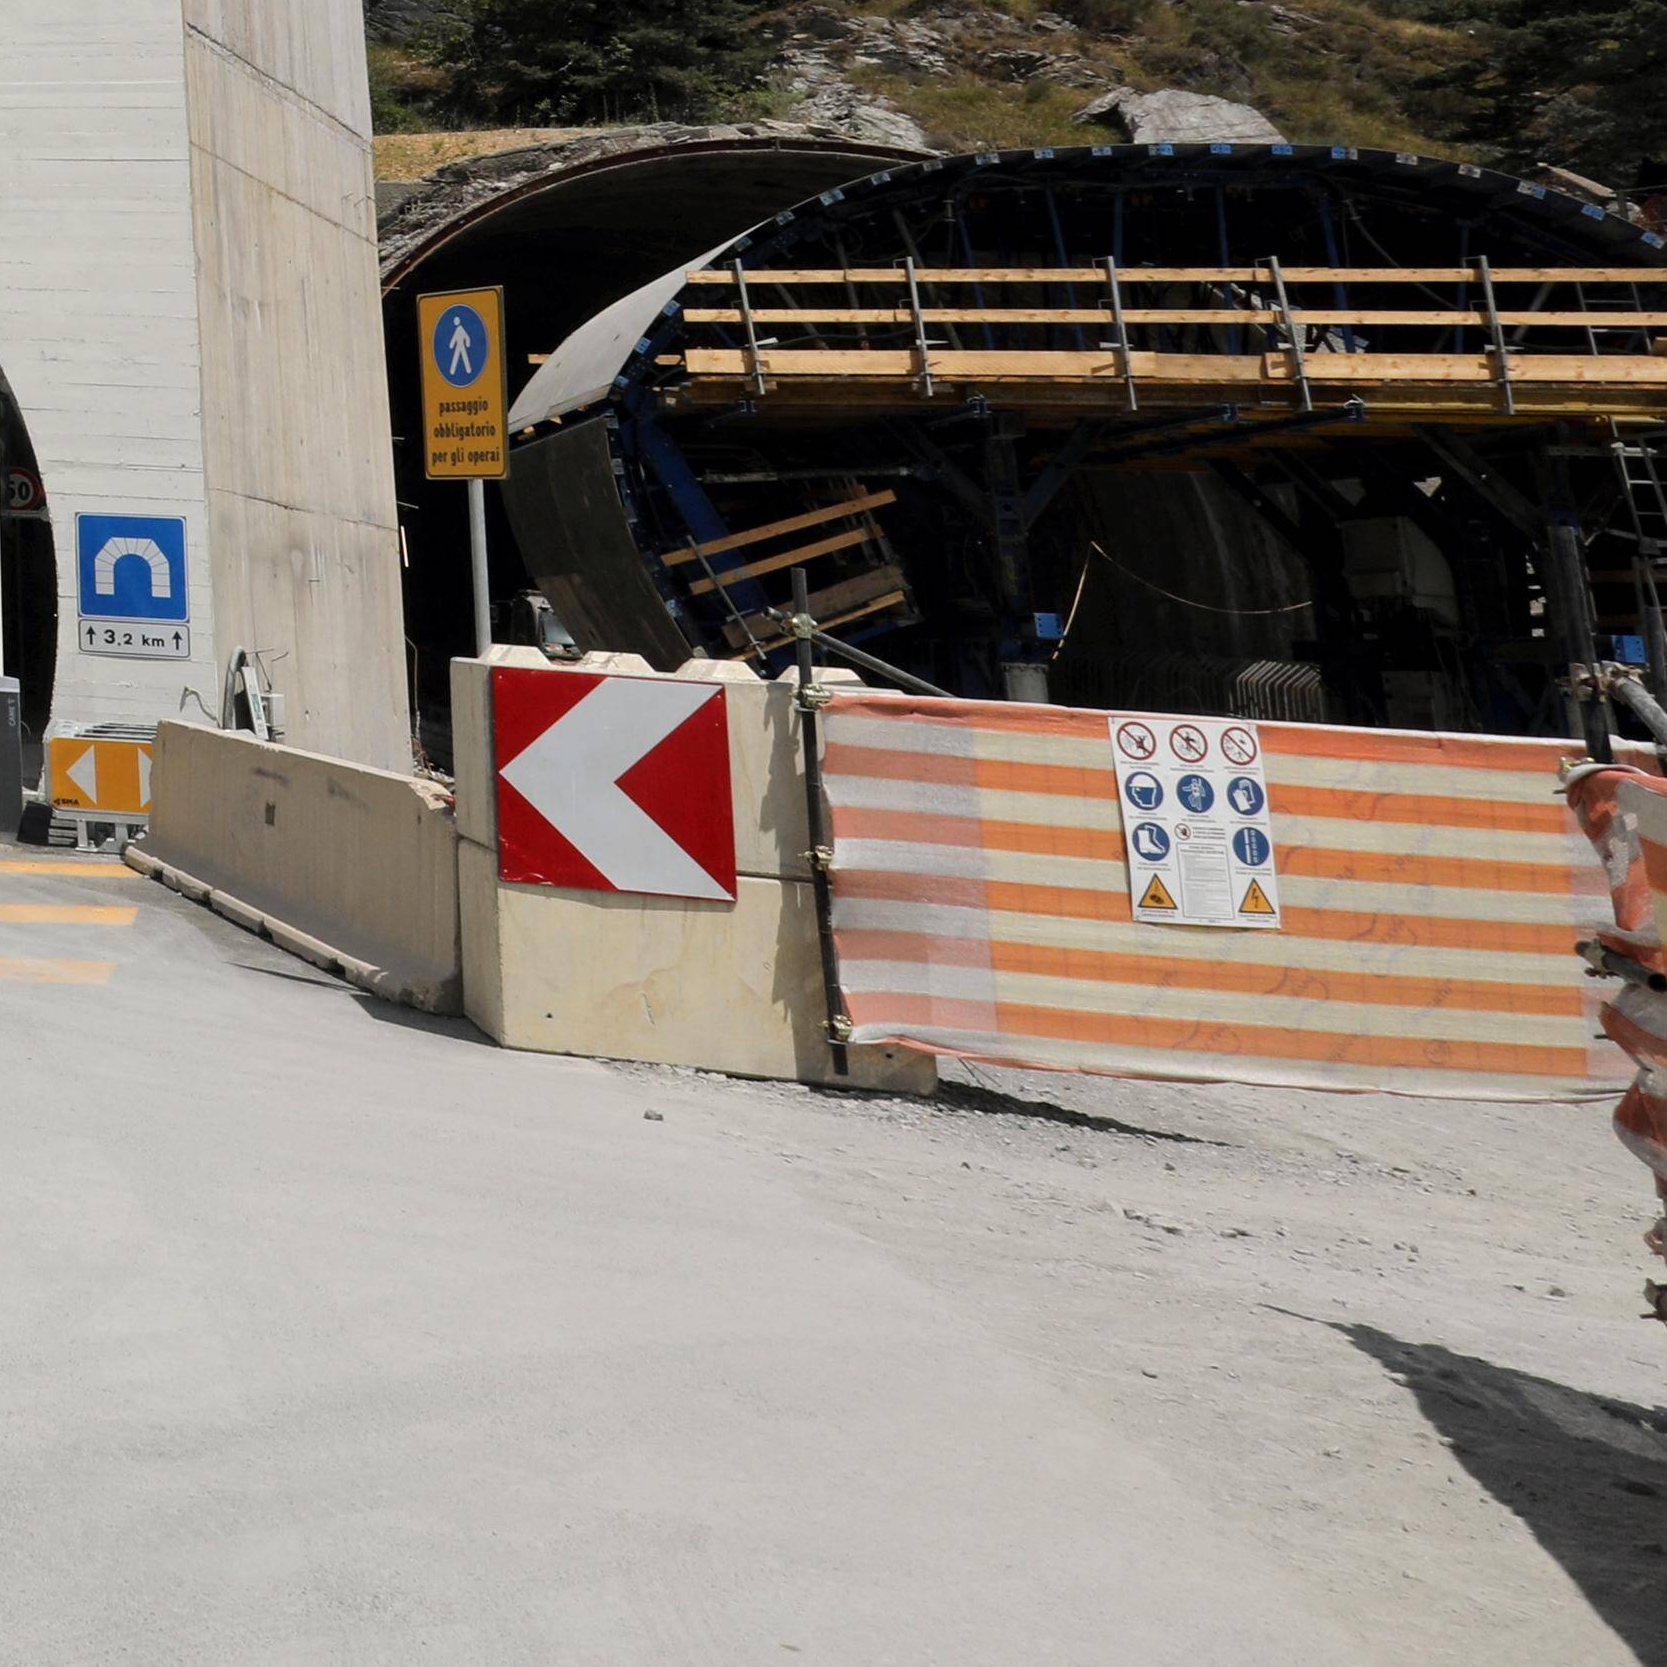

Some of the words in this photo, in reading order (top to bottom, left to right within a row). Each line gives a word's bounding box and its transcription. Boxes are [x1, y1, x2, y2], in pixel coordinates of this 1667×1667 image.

[439, 396, 488, 417] passaggio
[434, 420, 496, 441] obbligatorio
[432, 451, 447, 467] per
[451, 446, 465, 466] gli
[468, 446, 499, 466] operai
[104, 629, 133, 646] 3.2
[142, 634, 165, 647] km
